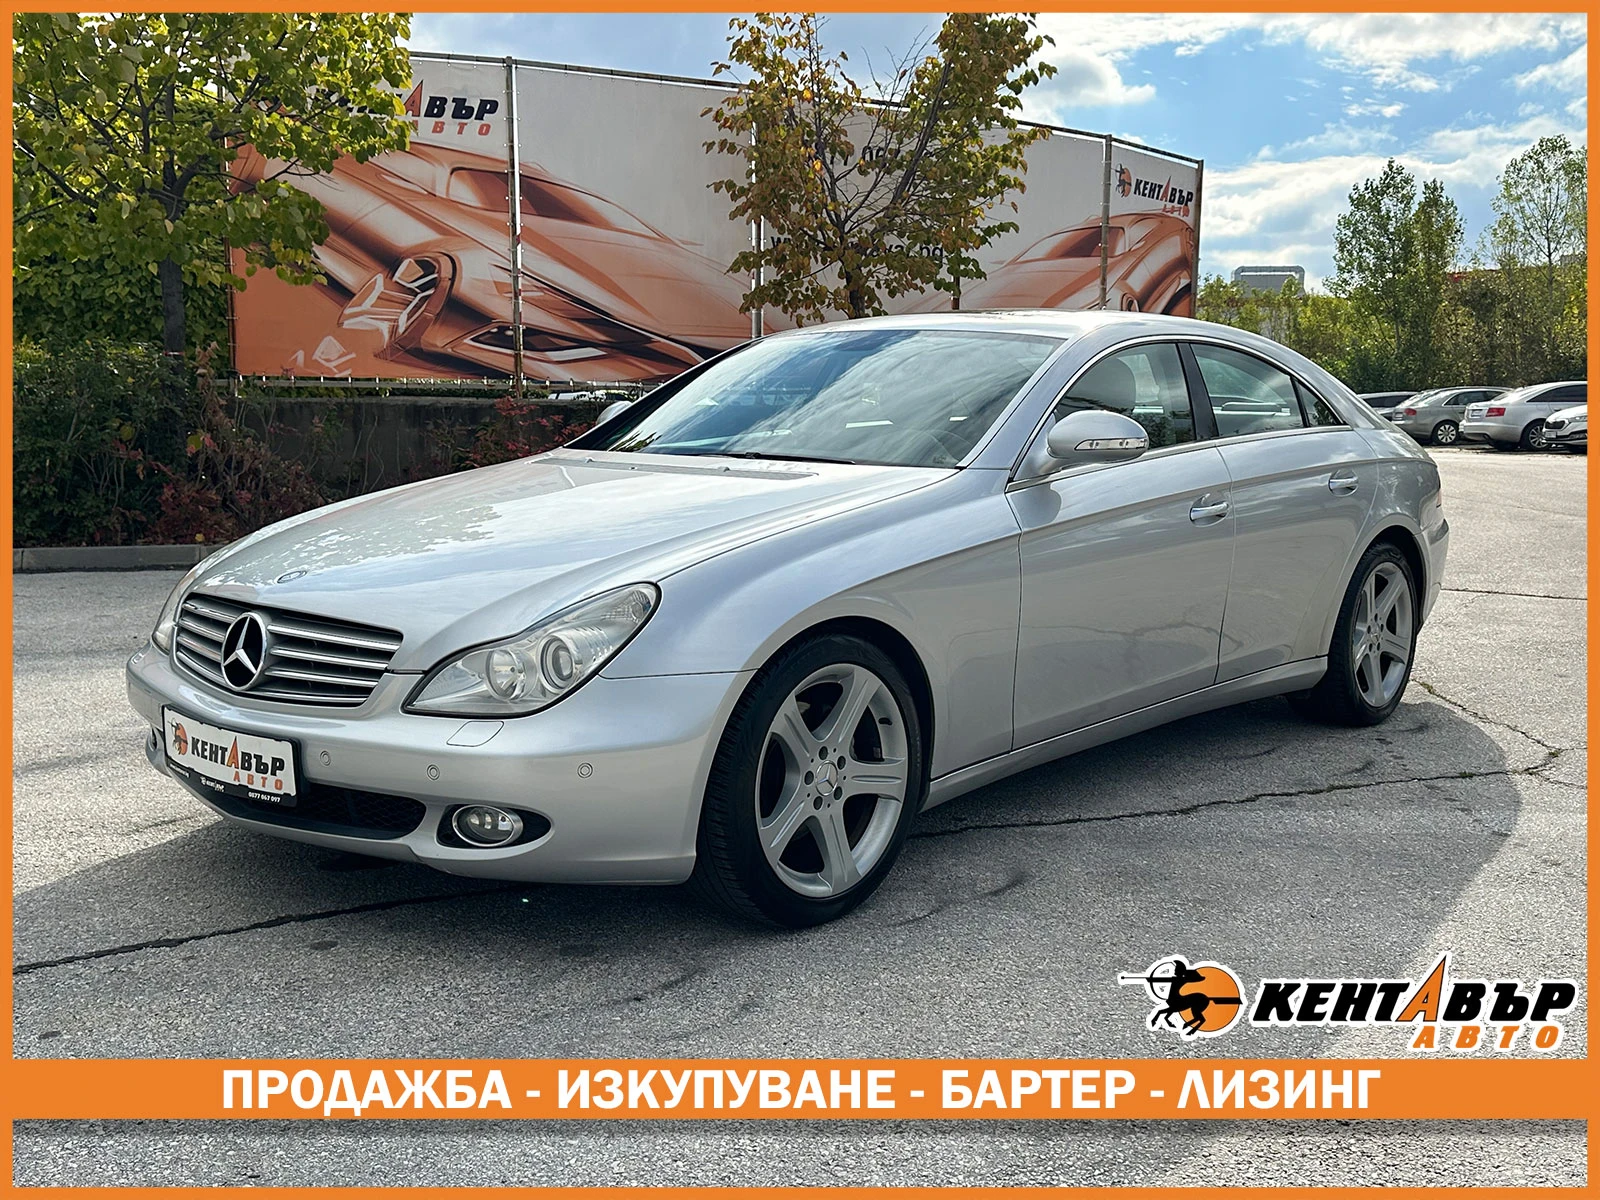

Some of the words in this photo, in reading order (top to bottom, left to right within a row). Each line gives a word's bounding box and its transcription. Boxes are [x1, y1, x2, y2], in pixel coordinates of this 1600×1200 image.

[1134, 175, 1194, 206] КЕНТАВЪР
[191, 736, 285, 776] КЕНТАВЪР
[233, 771, 283, 791] АВТО
